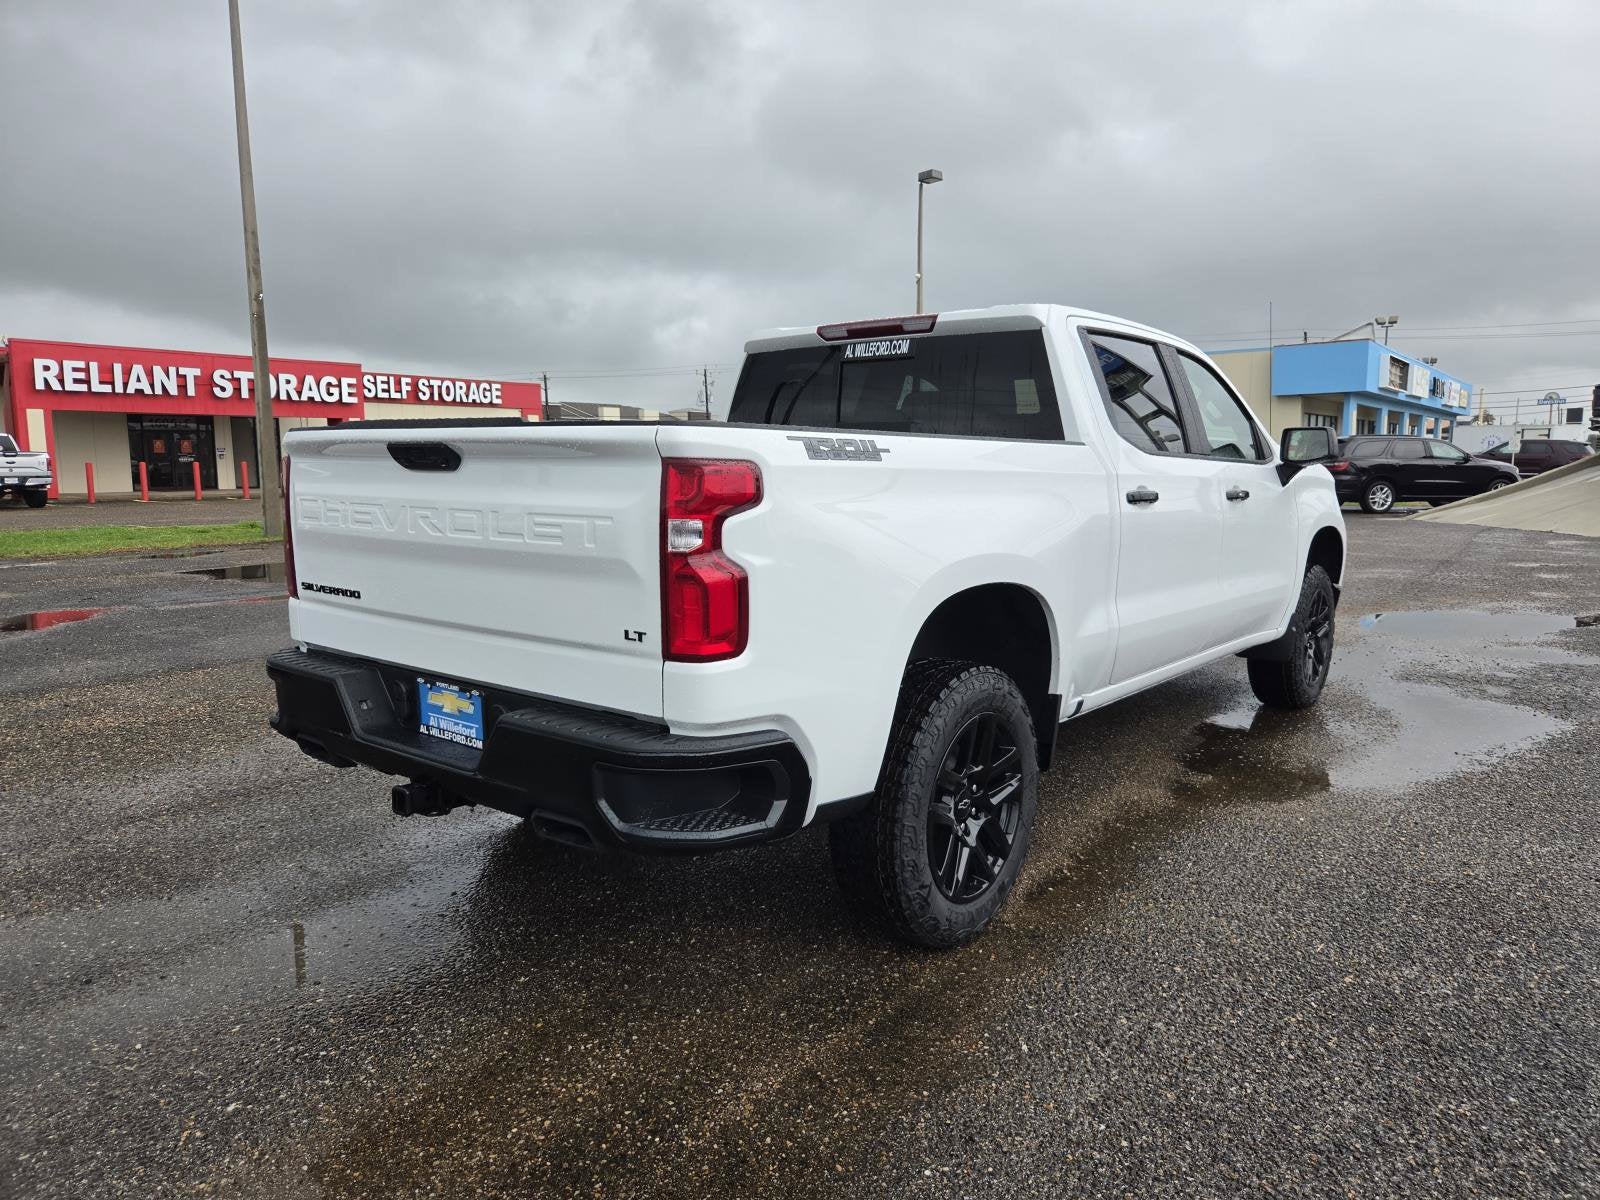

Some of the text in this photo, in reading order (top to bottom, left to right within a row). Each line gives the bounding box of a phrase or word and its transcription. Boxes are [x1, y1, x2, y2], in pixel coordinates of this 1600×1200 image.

[844, 339, 910, 359] AL WILLEFORD.COM
[33, 358, 201, 397] RELIANT
[363, 374, 503, 405] SELF STORAGE
[297, 498, 614, 549] CHEVROLET
[301, 582, 361, 600] SILVERADO
[624, 629, 647, 643] LT
[420, 724, 483, 750] AL WILLEFORD.COM
[429, 716, 477, 738] Al Willeford
